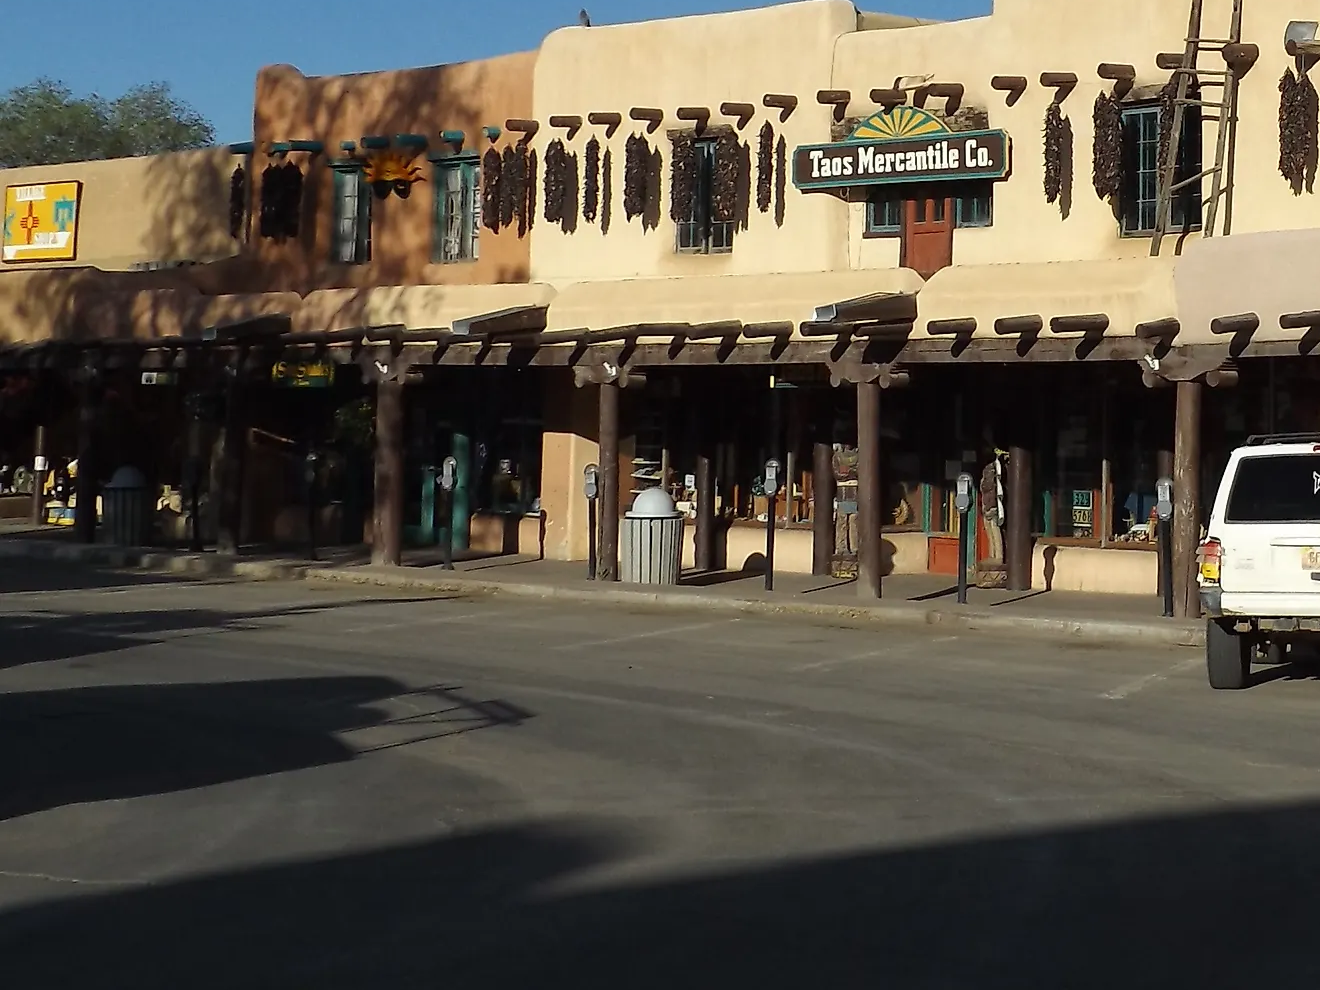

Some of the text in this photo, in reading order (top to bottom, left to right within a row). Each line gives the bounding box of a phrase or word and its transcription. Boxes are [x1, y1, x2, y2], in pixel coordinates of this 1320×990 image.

[809, 139, 994, 178] Taos Mercantile Co.
